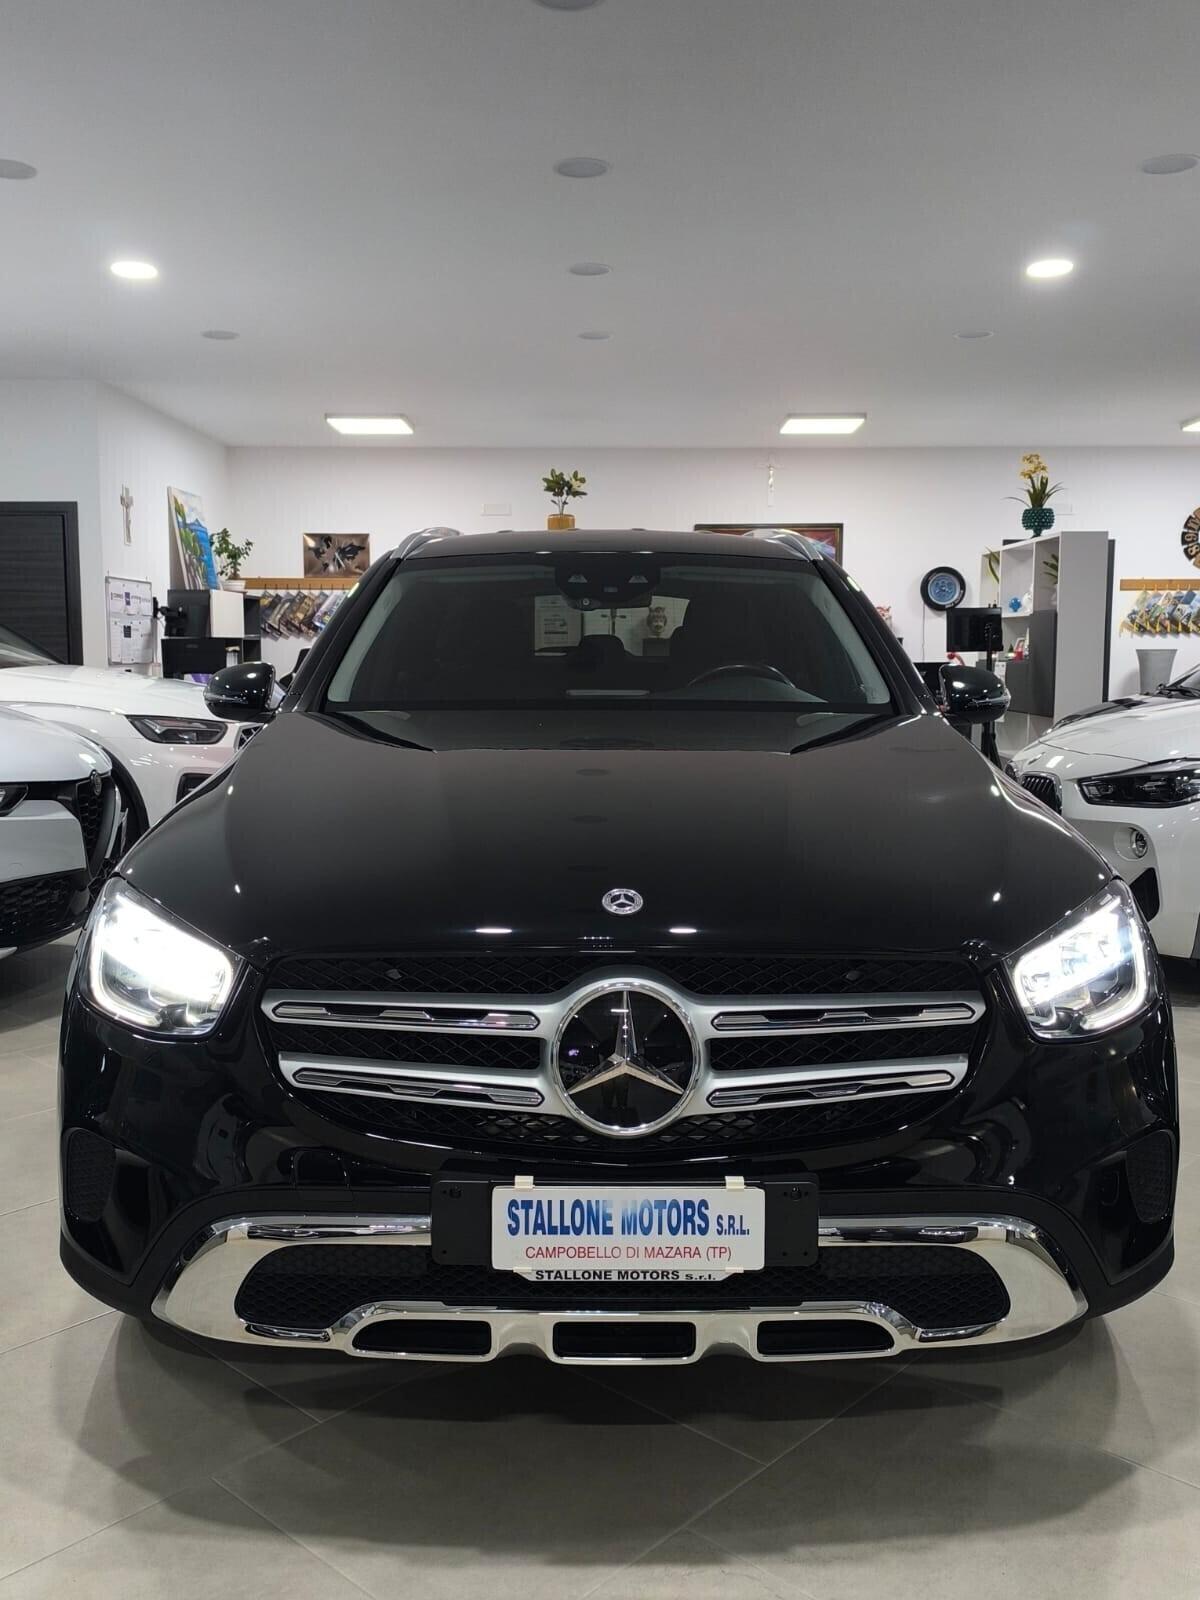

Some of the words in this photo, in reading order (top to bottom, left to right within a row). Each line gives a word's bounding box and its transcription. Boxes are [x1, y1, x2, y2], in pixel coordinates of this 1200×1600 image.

[508, 1199, 614, 1236] STALLONE
[621, 1199, 710, 1236] MOTORS
[716, 1214, 750, 1236] S.R.L.
[525, 1246, 621, 1259] CAMPOBELLO
[626, 1246, 640, 1259] DI
[644, 1246, 702, 1259] MAZARA
[706, 1246, 732, 1261] (TP)
[535, 1270, 612, 1280] STALLONE
[617, 1270, 680, 1280] MOTORS
